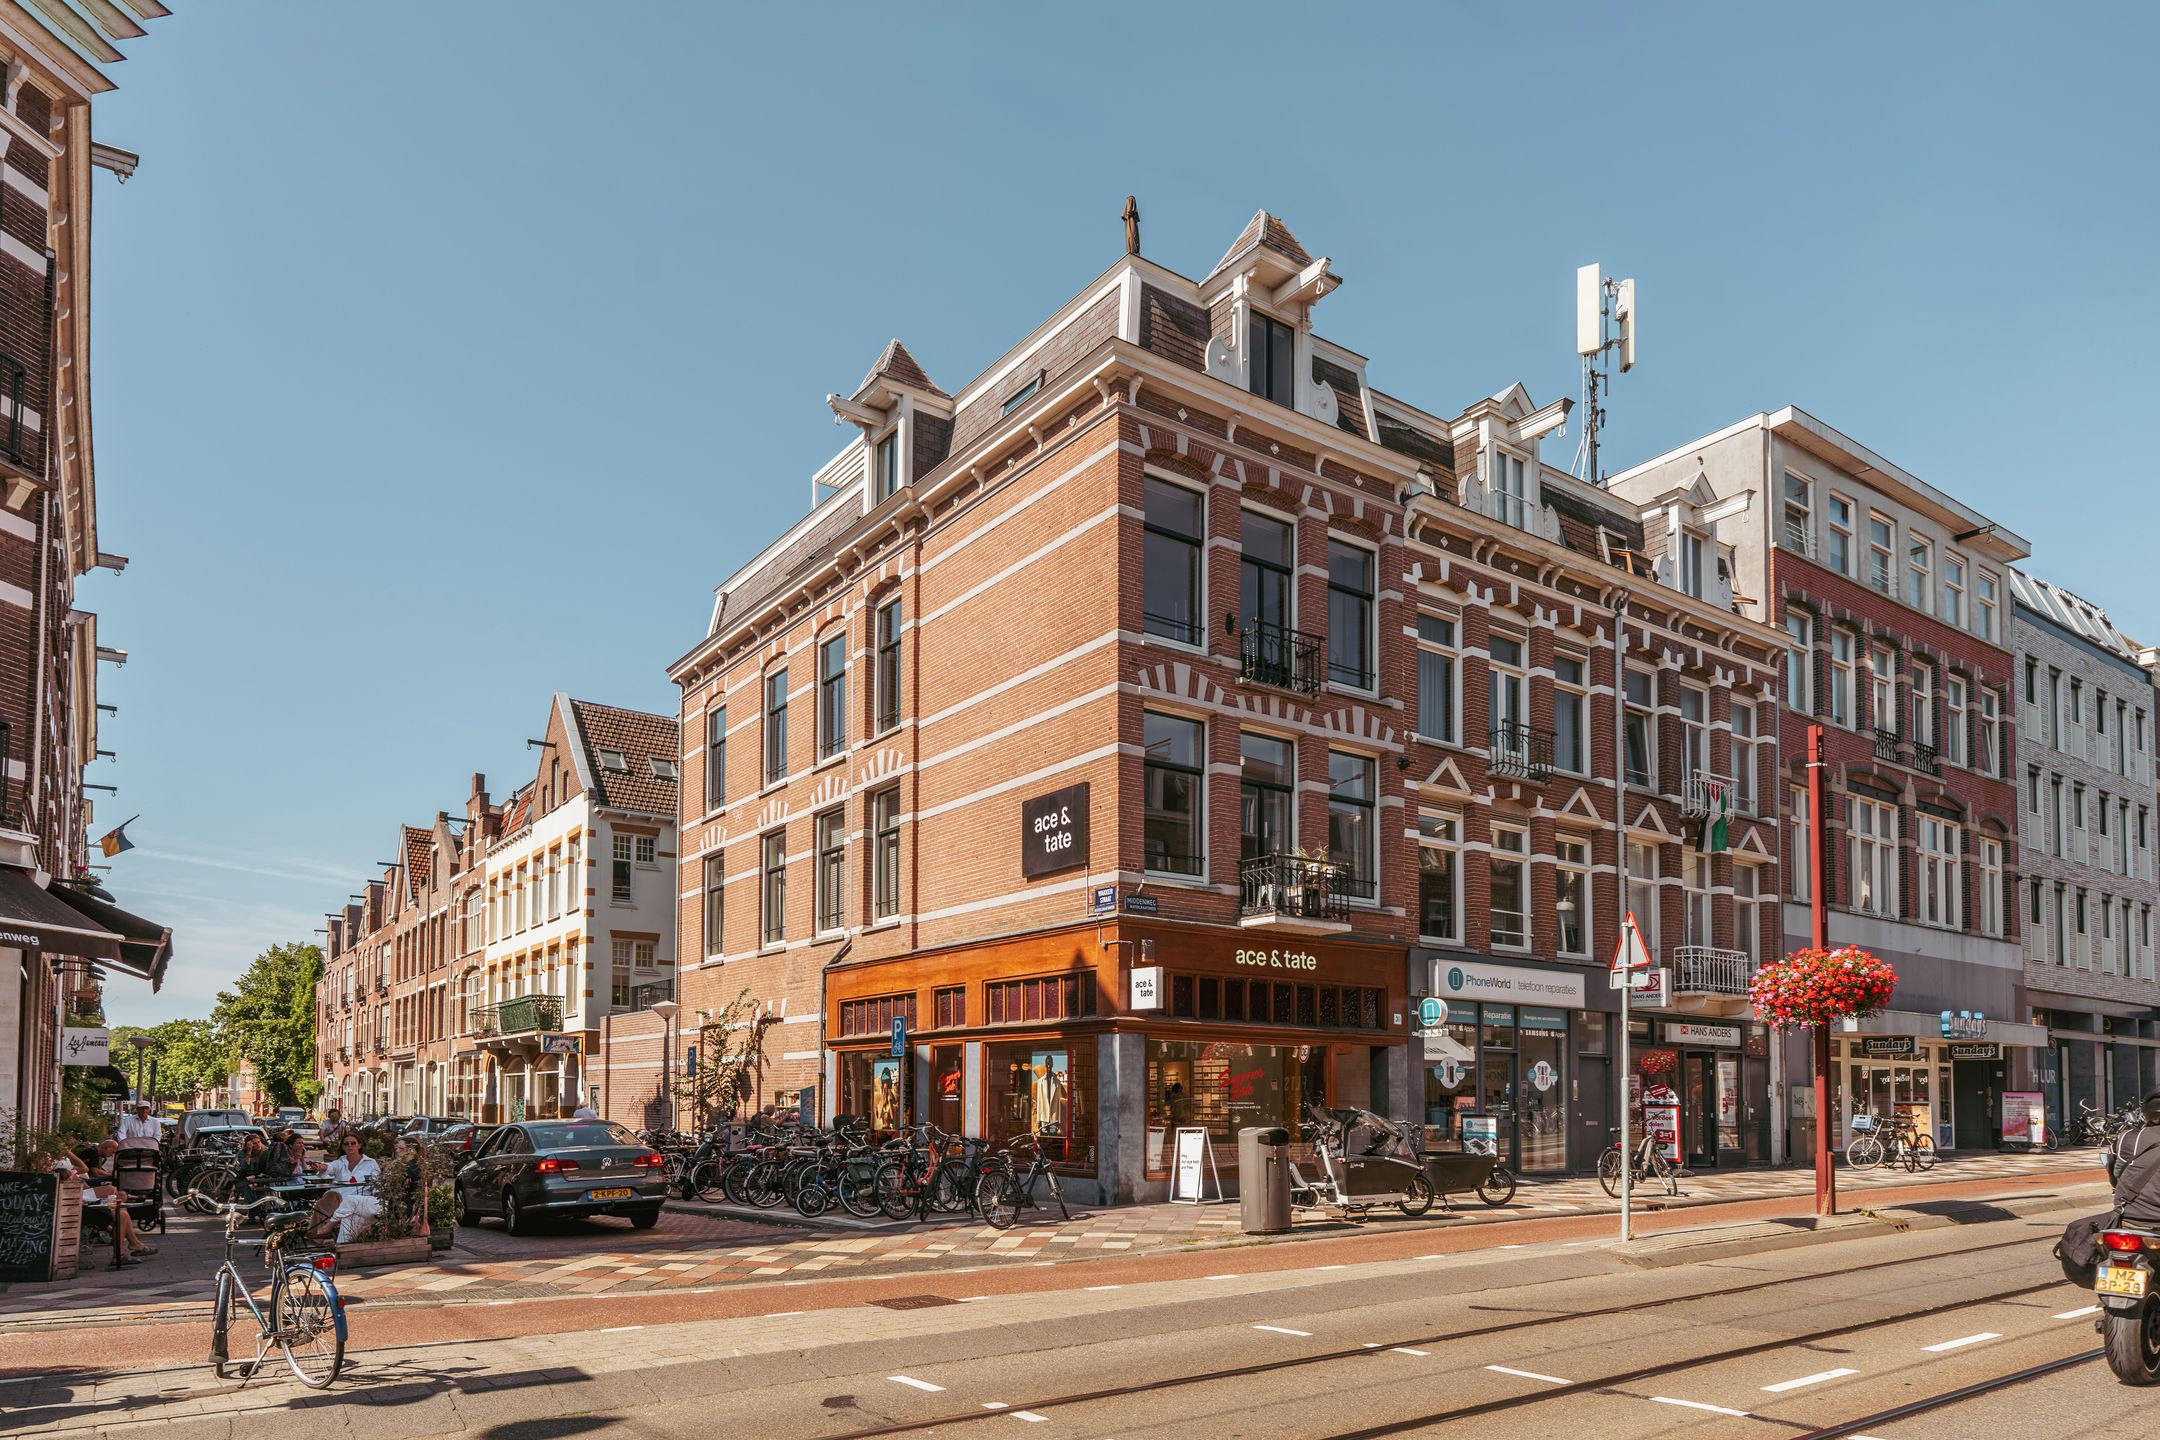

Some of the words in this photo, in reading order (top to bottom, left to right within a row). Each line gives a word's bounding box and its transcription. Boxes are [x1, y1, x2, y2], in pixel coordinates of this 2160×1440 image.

[1034, 812, 1058, 833] ace
[1060, 806, 1071, 825] &
[1045, 830, 1072, 853] tate
[1126, 897, 1157, 906] MIDDENWEG
[1235, 949, 1267, 966] ace
[1270, 949, 1283, 968] &
[1284, 951, 1317, 970] tate
[1135, 980, 1147, 989] ace
[1147, 979, 1153, 988] &
[1465, 974, 1511, 990] PhoneWorld
[1517, 980, 1545, 992] telefoon
[1545, 983, 1577, 996] reparaties
[1140, 988, 1153, 998] tate
[1483, 1010, 1512, 1020] Reparatie
[894, 1020, 902, 1040] P
[1525, 1029, 1549, 1037] SAMSUNG
[1690, 1026, 1708, 1037] HANS
[1708, 1028, 1732, 1039] ANDERS
[1866, 1037, 1911, 1052] Sunday's
[1951, 1044, 1996, 1057] Sunday's
[1659, 1130, 1673, 1139] 3=1
[593, 1189, 629, 1199] 2-KPF-20
[0, 1236, 48, 1255] MAZING
[2115, 1269, 2136, 1282] MZ
